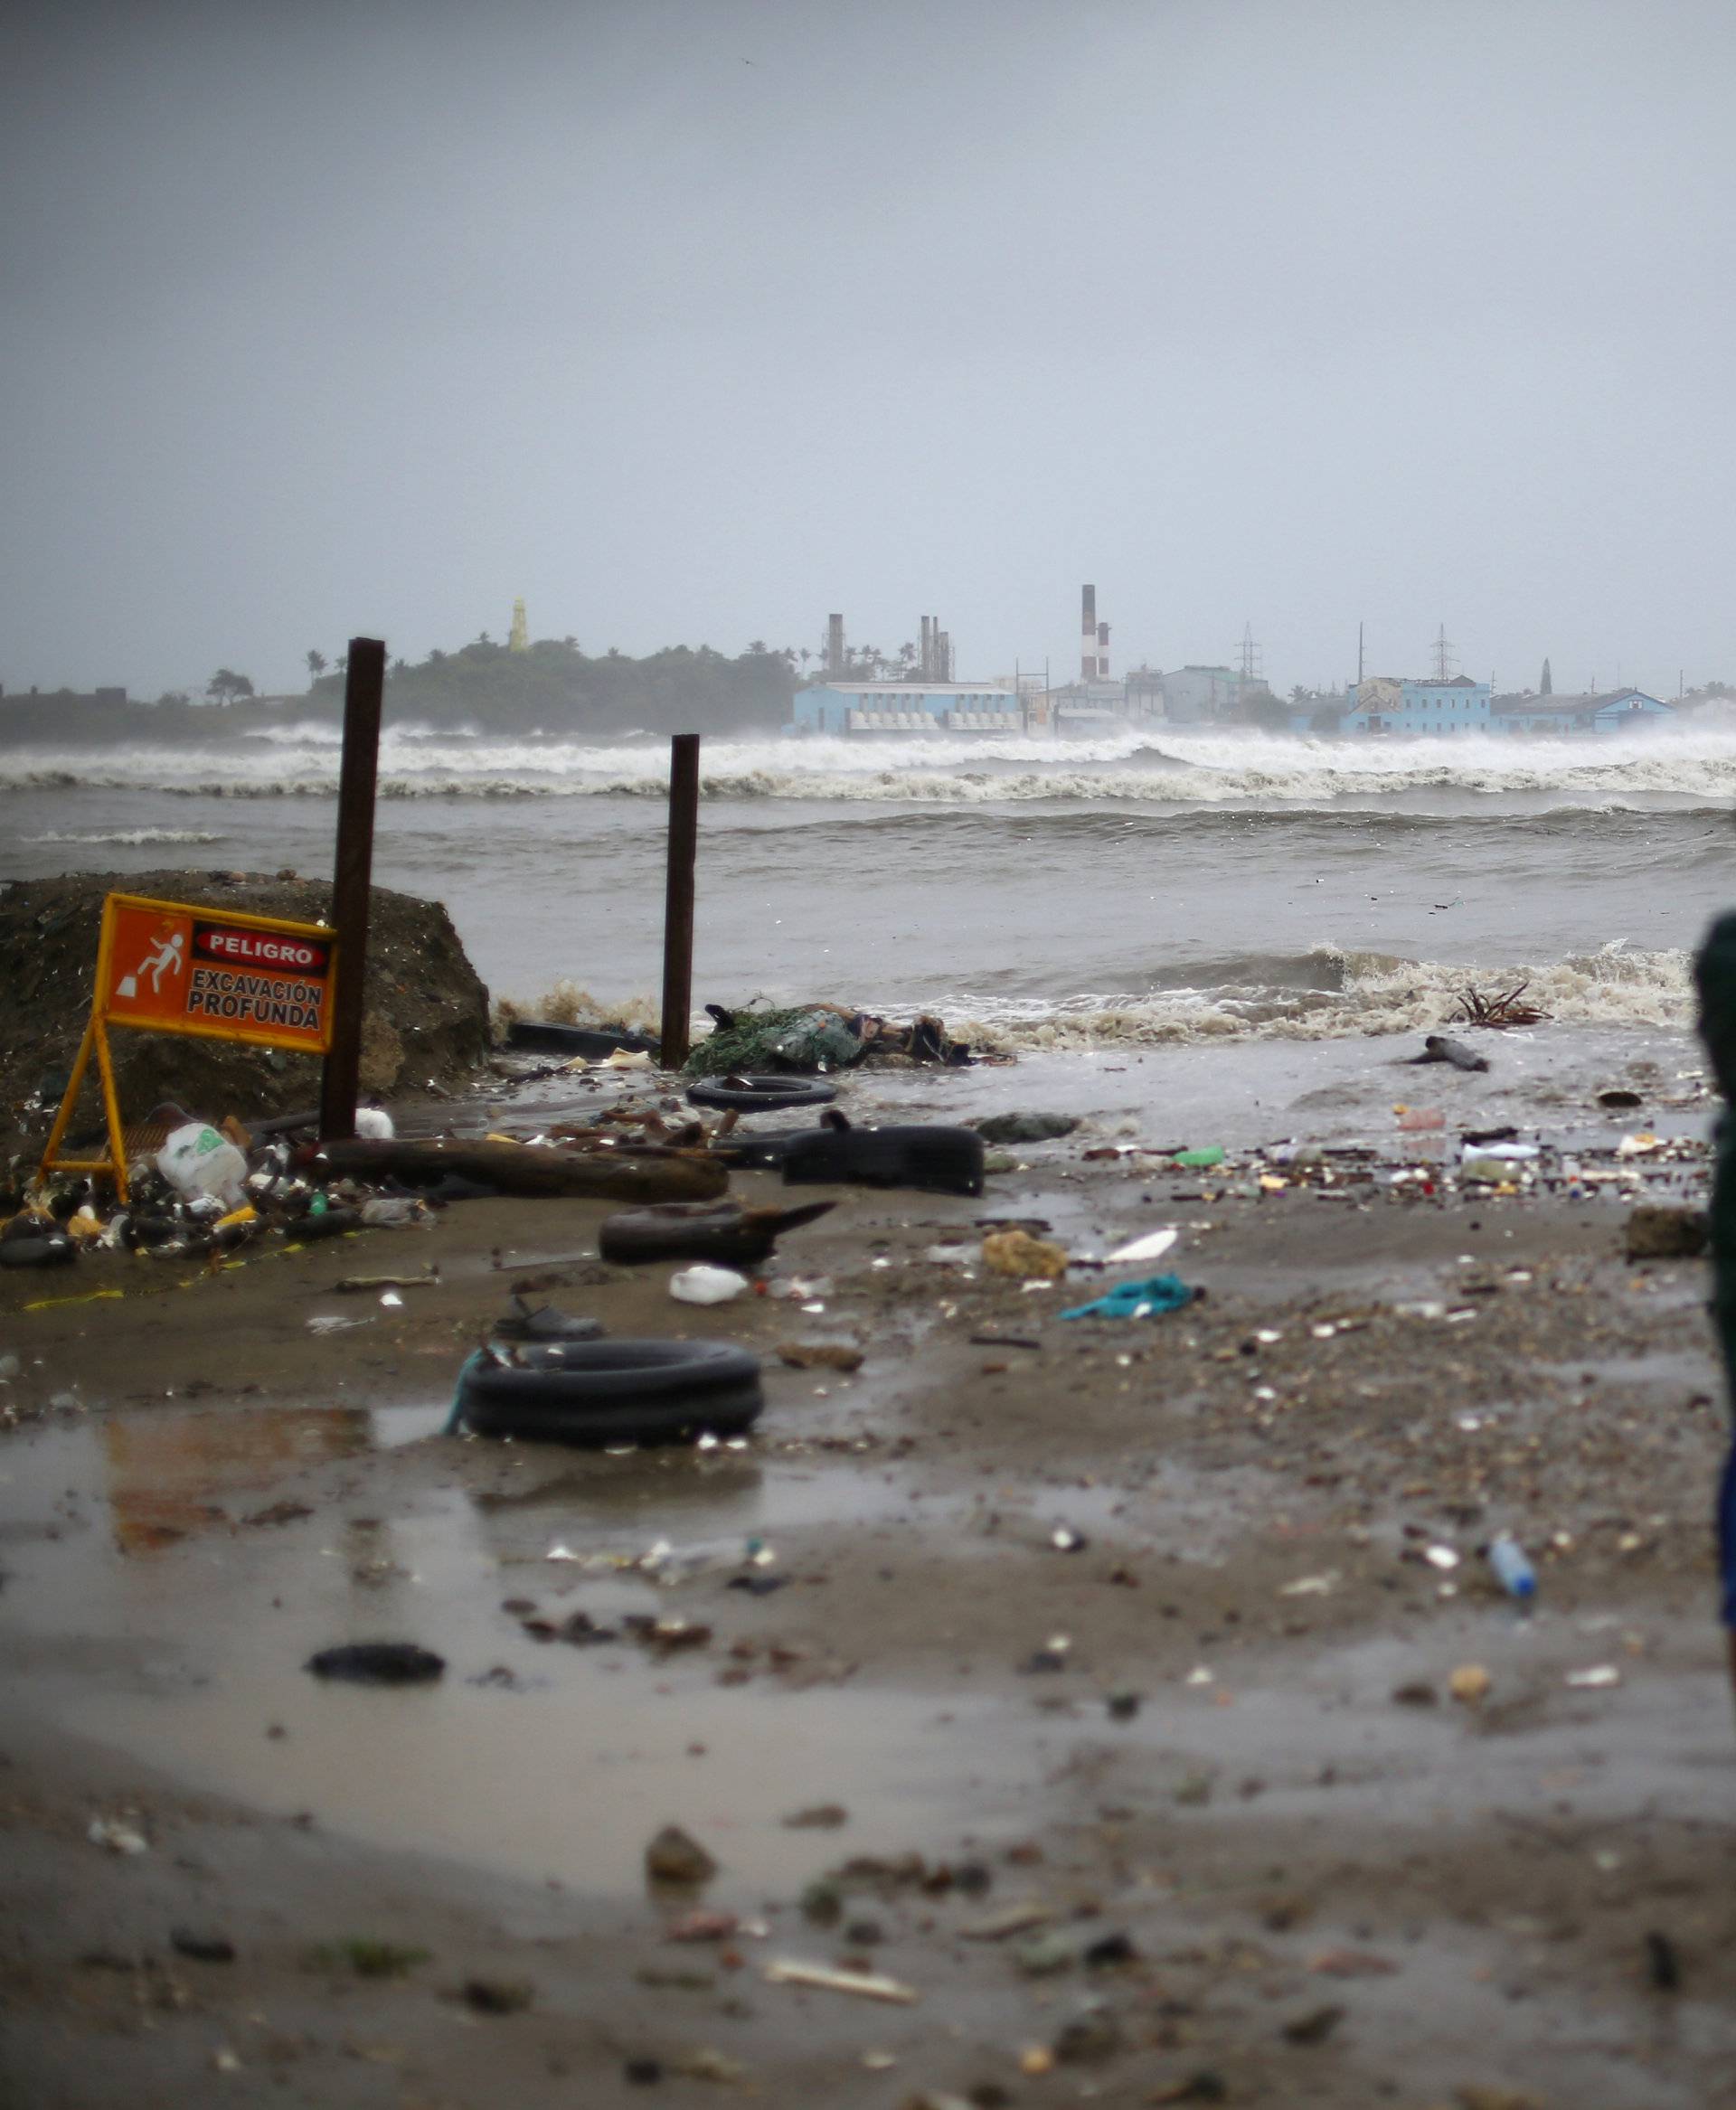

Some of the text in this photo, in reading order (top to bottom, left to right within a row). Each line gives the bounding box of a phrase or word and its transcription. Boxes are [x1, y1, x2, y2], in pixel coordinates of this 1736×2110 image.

[209, 935, 313, 964] PELIGRO
[193, 968, 322, 1006] EXCAVACIÓN
[187, 989, 320, 1030] PROFUNDA
